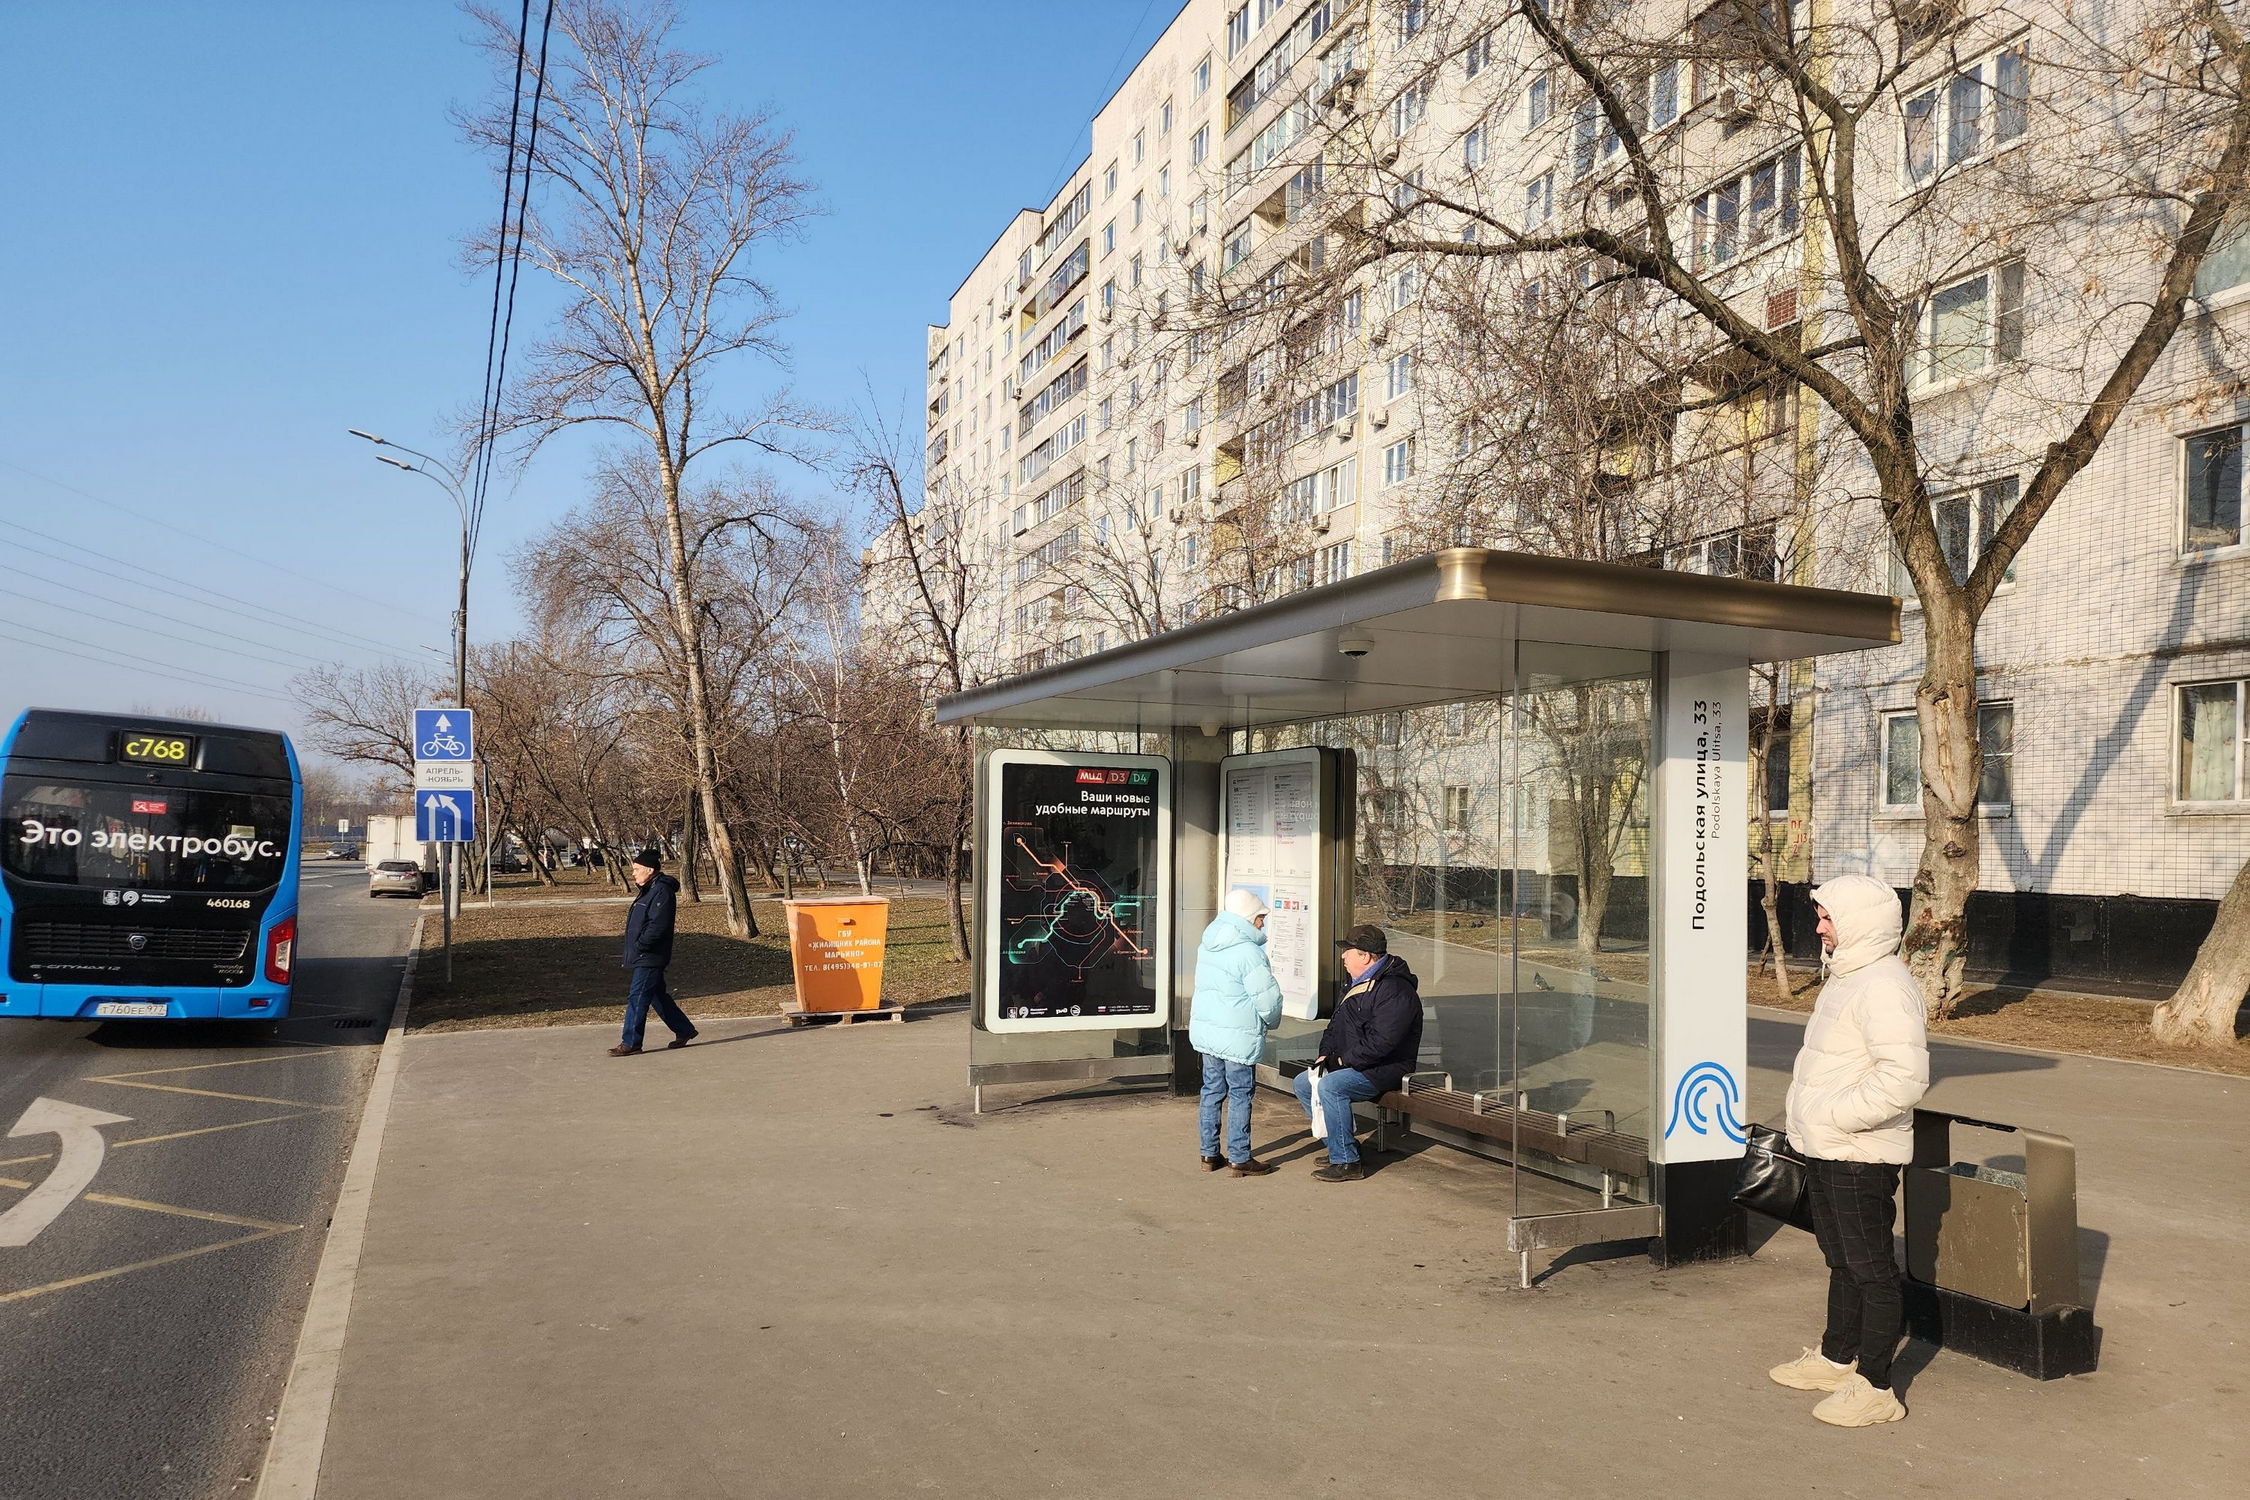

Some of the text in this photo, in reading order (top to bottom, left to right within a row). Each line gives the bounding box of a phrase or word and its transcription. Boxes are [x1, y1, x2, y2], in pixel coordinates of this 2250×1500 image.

[126, 738, 186, 760] с768
[1079, 771, 1148, 783] МЦД D3 D4
[1711, 701, 1723, 839] Podolskaya Ulitsa, 33
[1081, 790, 1151, 803] Ваши новые
[1035, 802, 1151, 819] удобные маршруты
[1692, 700, 1709, 929] Подольская улица, 33
[20, 819, 281, 861] Это электробус.
[206, 898, 251, 909] 460168
